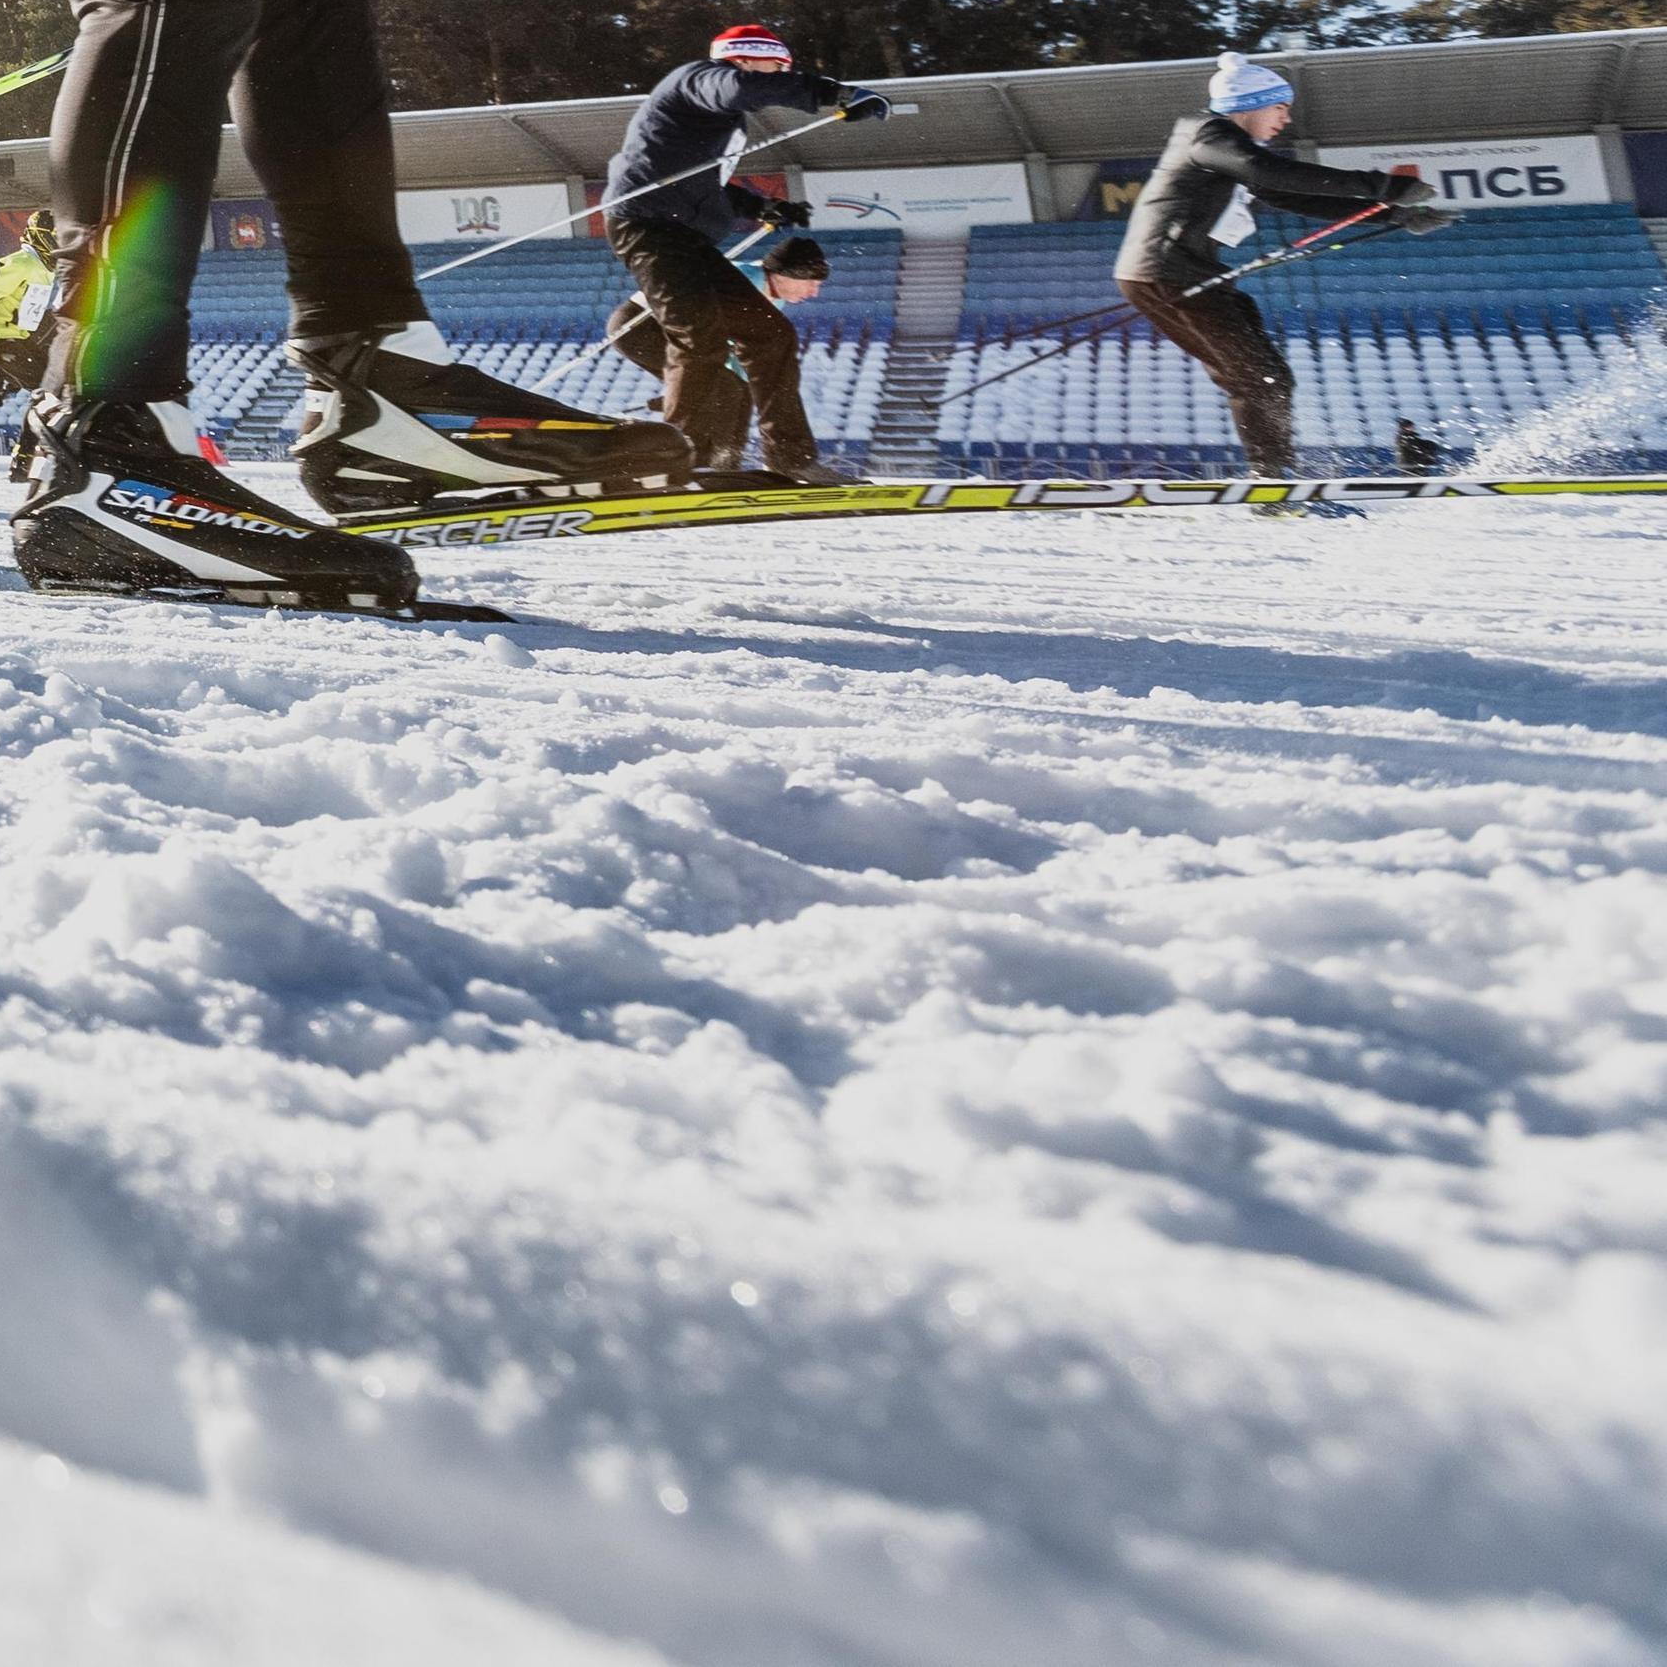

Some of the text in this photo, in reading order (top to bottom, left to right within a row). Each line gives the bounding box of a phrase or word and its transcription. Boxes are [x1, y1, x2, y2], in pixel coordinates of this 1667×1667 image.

[1439, 165, 1566, 200] ПСБ
[103, 488, 315, 540] SALOMON
[361, 509, 595, 549] FISCHER
